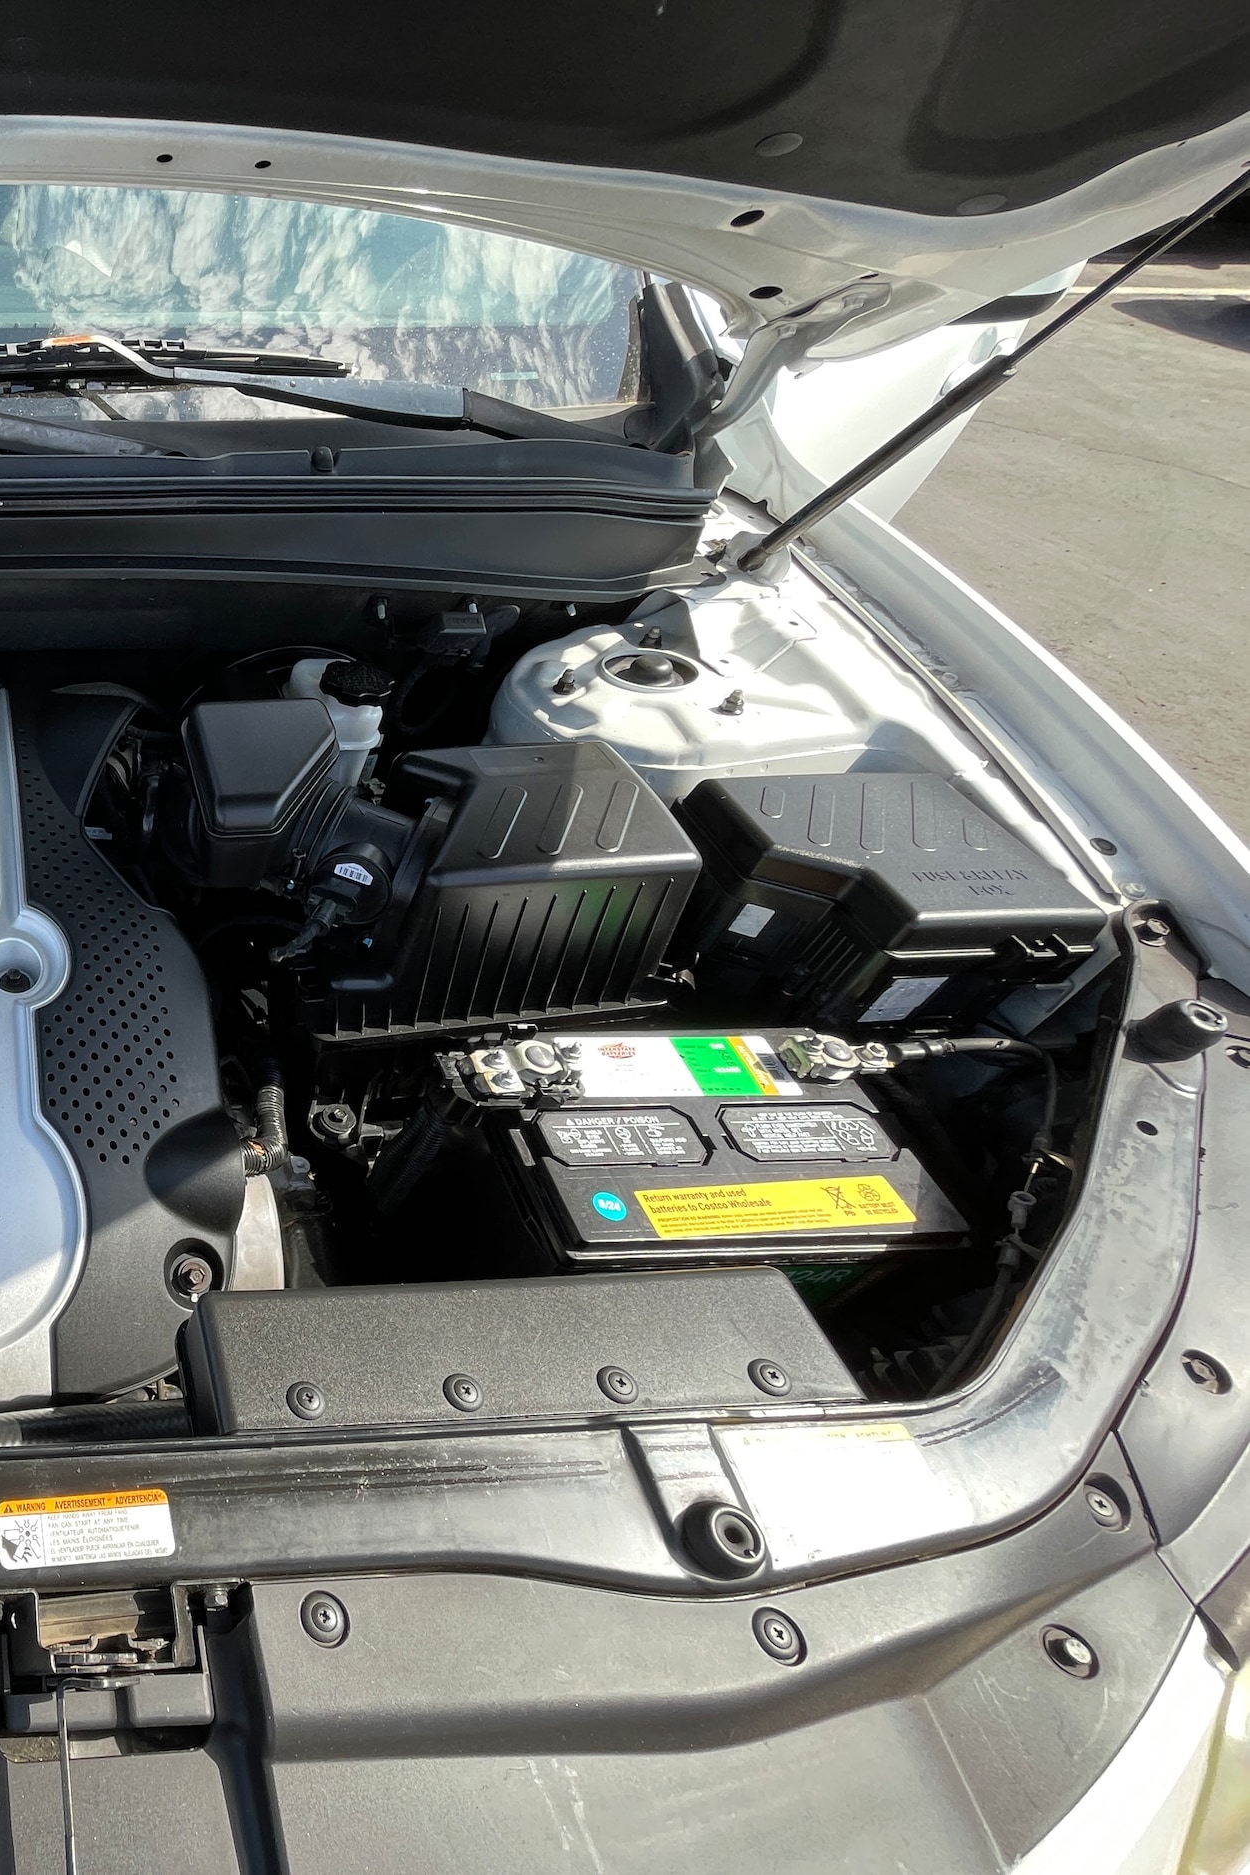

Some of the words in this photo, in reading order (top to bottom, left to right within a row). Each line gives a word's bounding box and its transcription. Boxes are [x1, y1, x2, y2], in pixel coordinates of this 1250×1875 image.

[574, 1117, 615, 1126] DANGER
[622, 1115, 660, 1124] POISON
[642, 1194, 672, 1203] Return
[672, 1192, 709, 1202] warranty
[710, 1190, 726, 1198] and
[727, 1188, 747, 1197] used
[649, 1204, 687, 1214] batteries
[688, 1203, 698, 1211] to
[698, 1201, 728, 1211] Costco
[729, 1198, 773, 1209] Wholesale
[15, 1502, 46, 1513] WARNING
[54, 1497, 106, 1510] AVERTISSEMENT
[115, 1493, 159, 1505] ADVERTENCIA
[75, 1519, 91, 1527] START
[62, 1537, 80, 1545] MAINS
